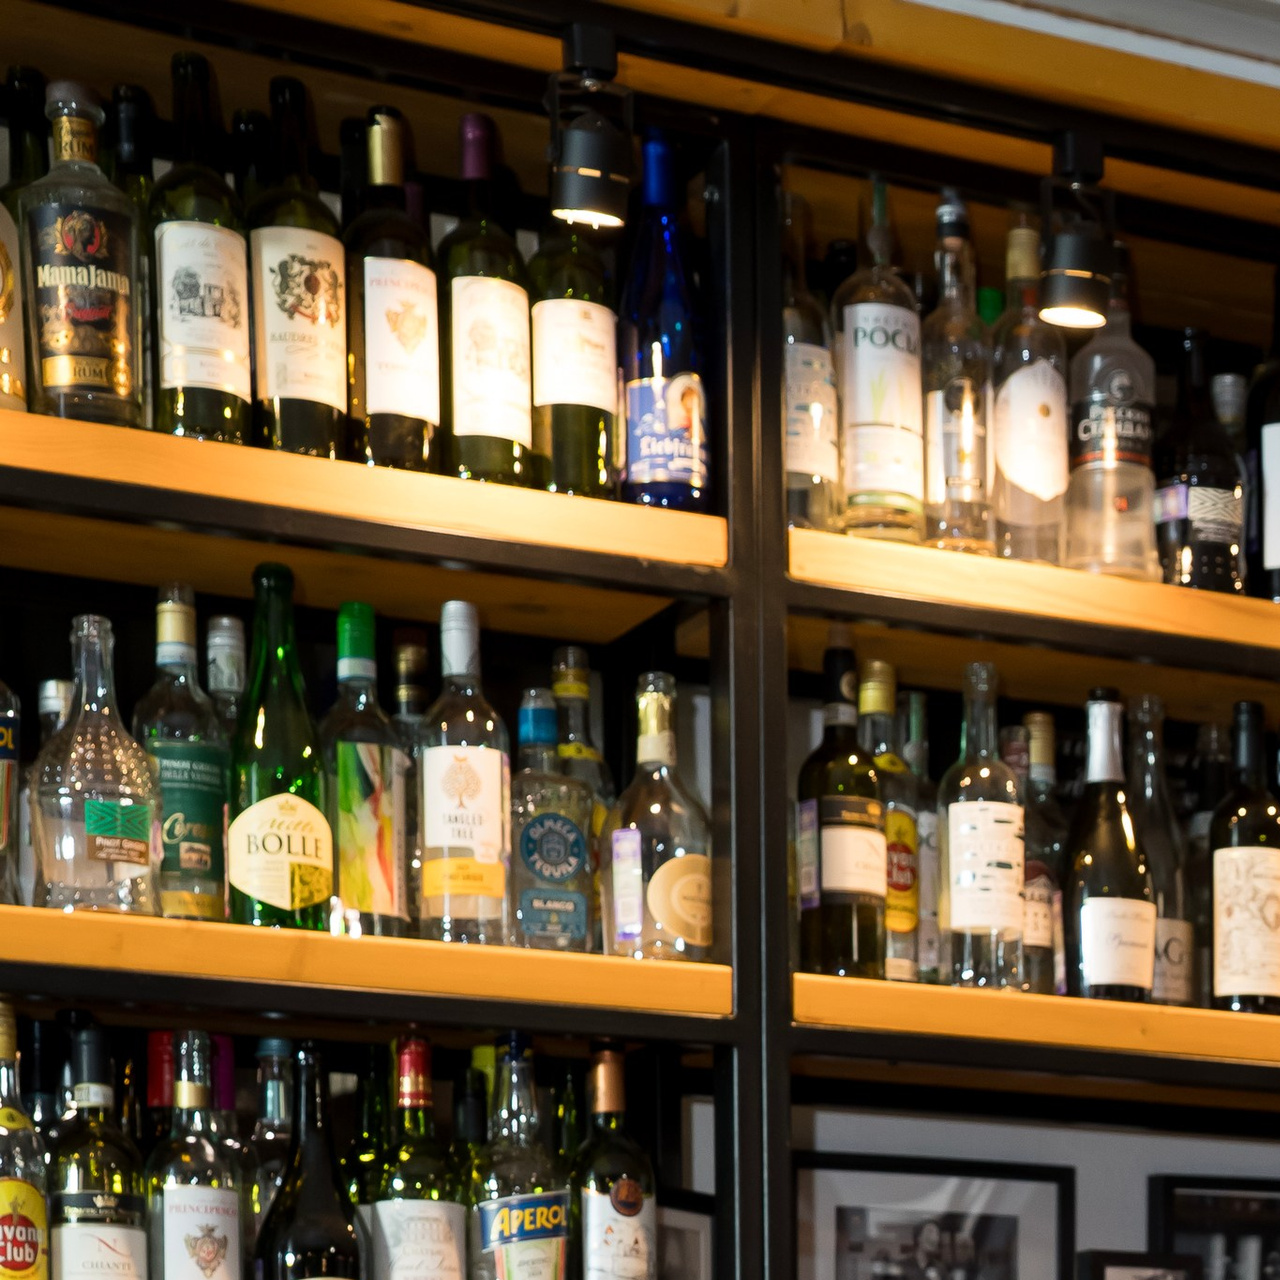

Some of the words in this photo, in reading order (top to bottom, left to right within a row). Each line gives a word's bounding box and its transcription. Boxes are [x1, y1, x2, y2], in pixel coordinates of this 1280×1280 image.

[37, 264, 131, 297] MamaJama
[246, 833, 322, 859] BOLLE
[490, 1206, 567, 1242] APEROL
